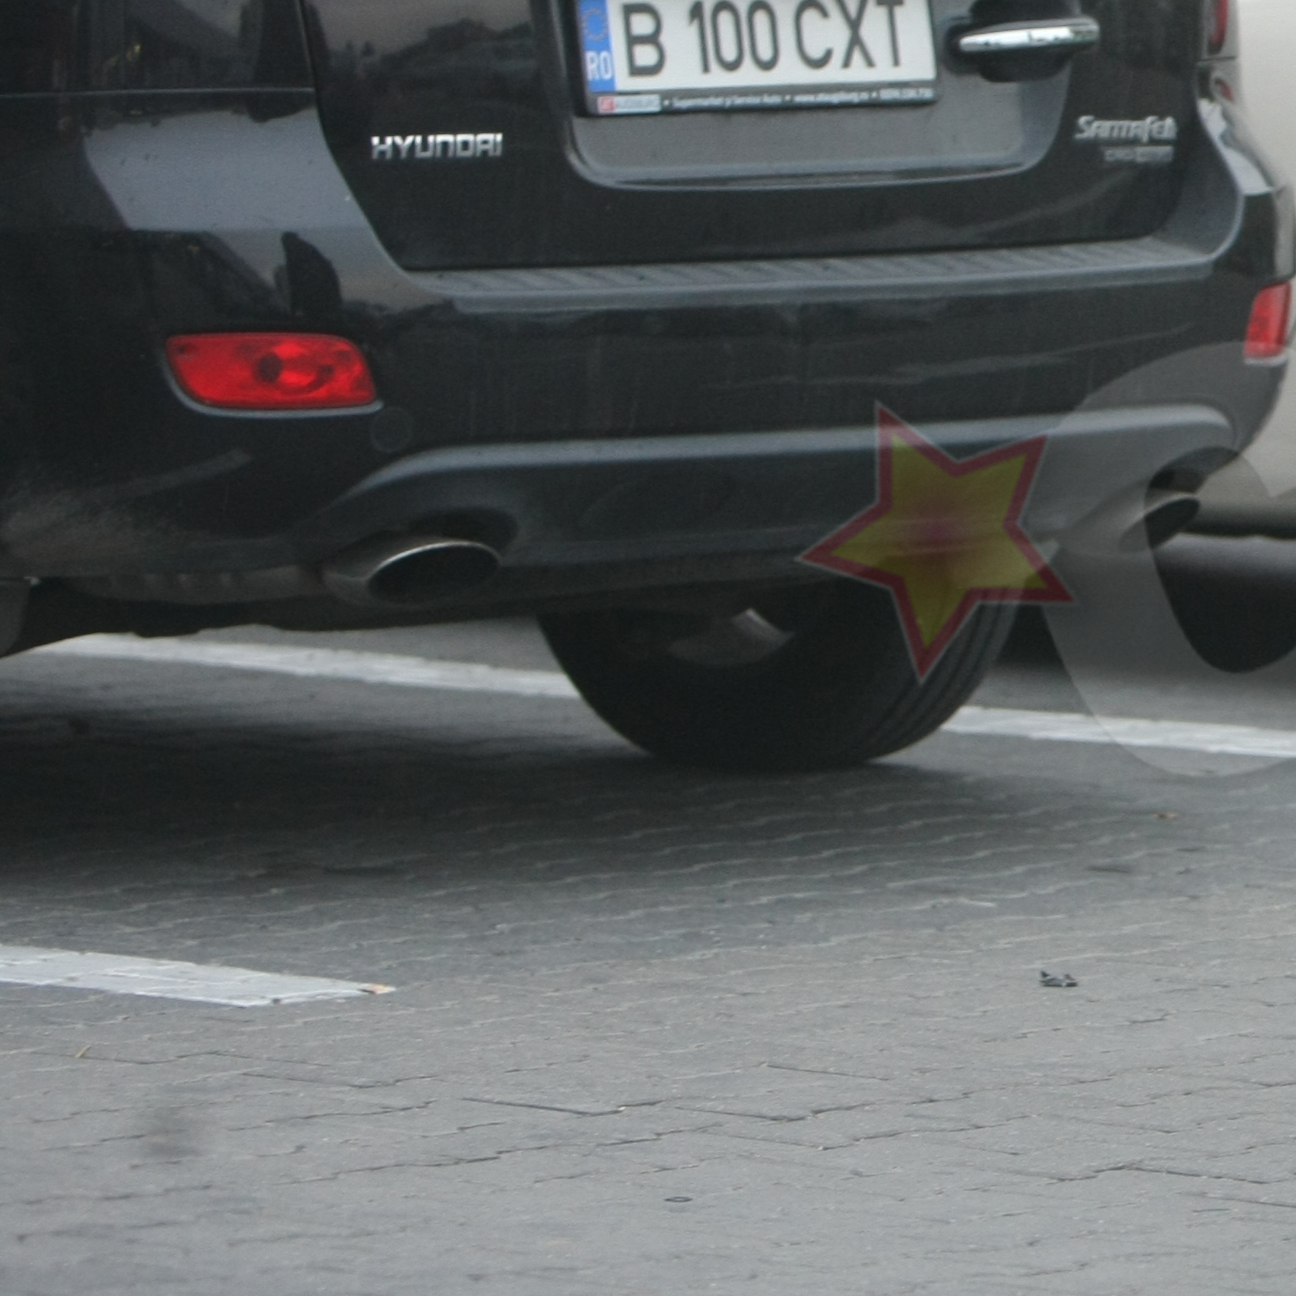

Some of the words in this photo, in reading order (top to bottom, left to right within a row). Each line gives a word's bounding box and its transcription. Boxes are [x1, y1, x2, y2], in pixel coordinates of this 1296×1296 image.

[619, 3, 667, 77] B
[586, 50, 613, 81] RO
[371, 133, 503, 159] HYUNDAI
